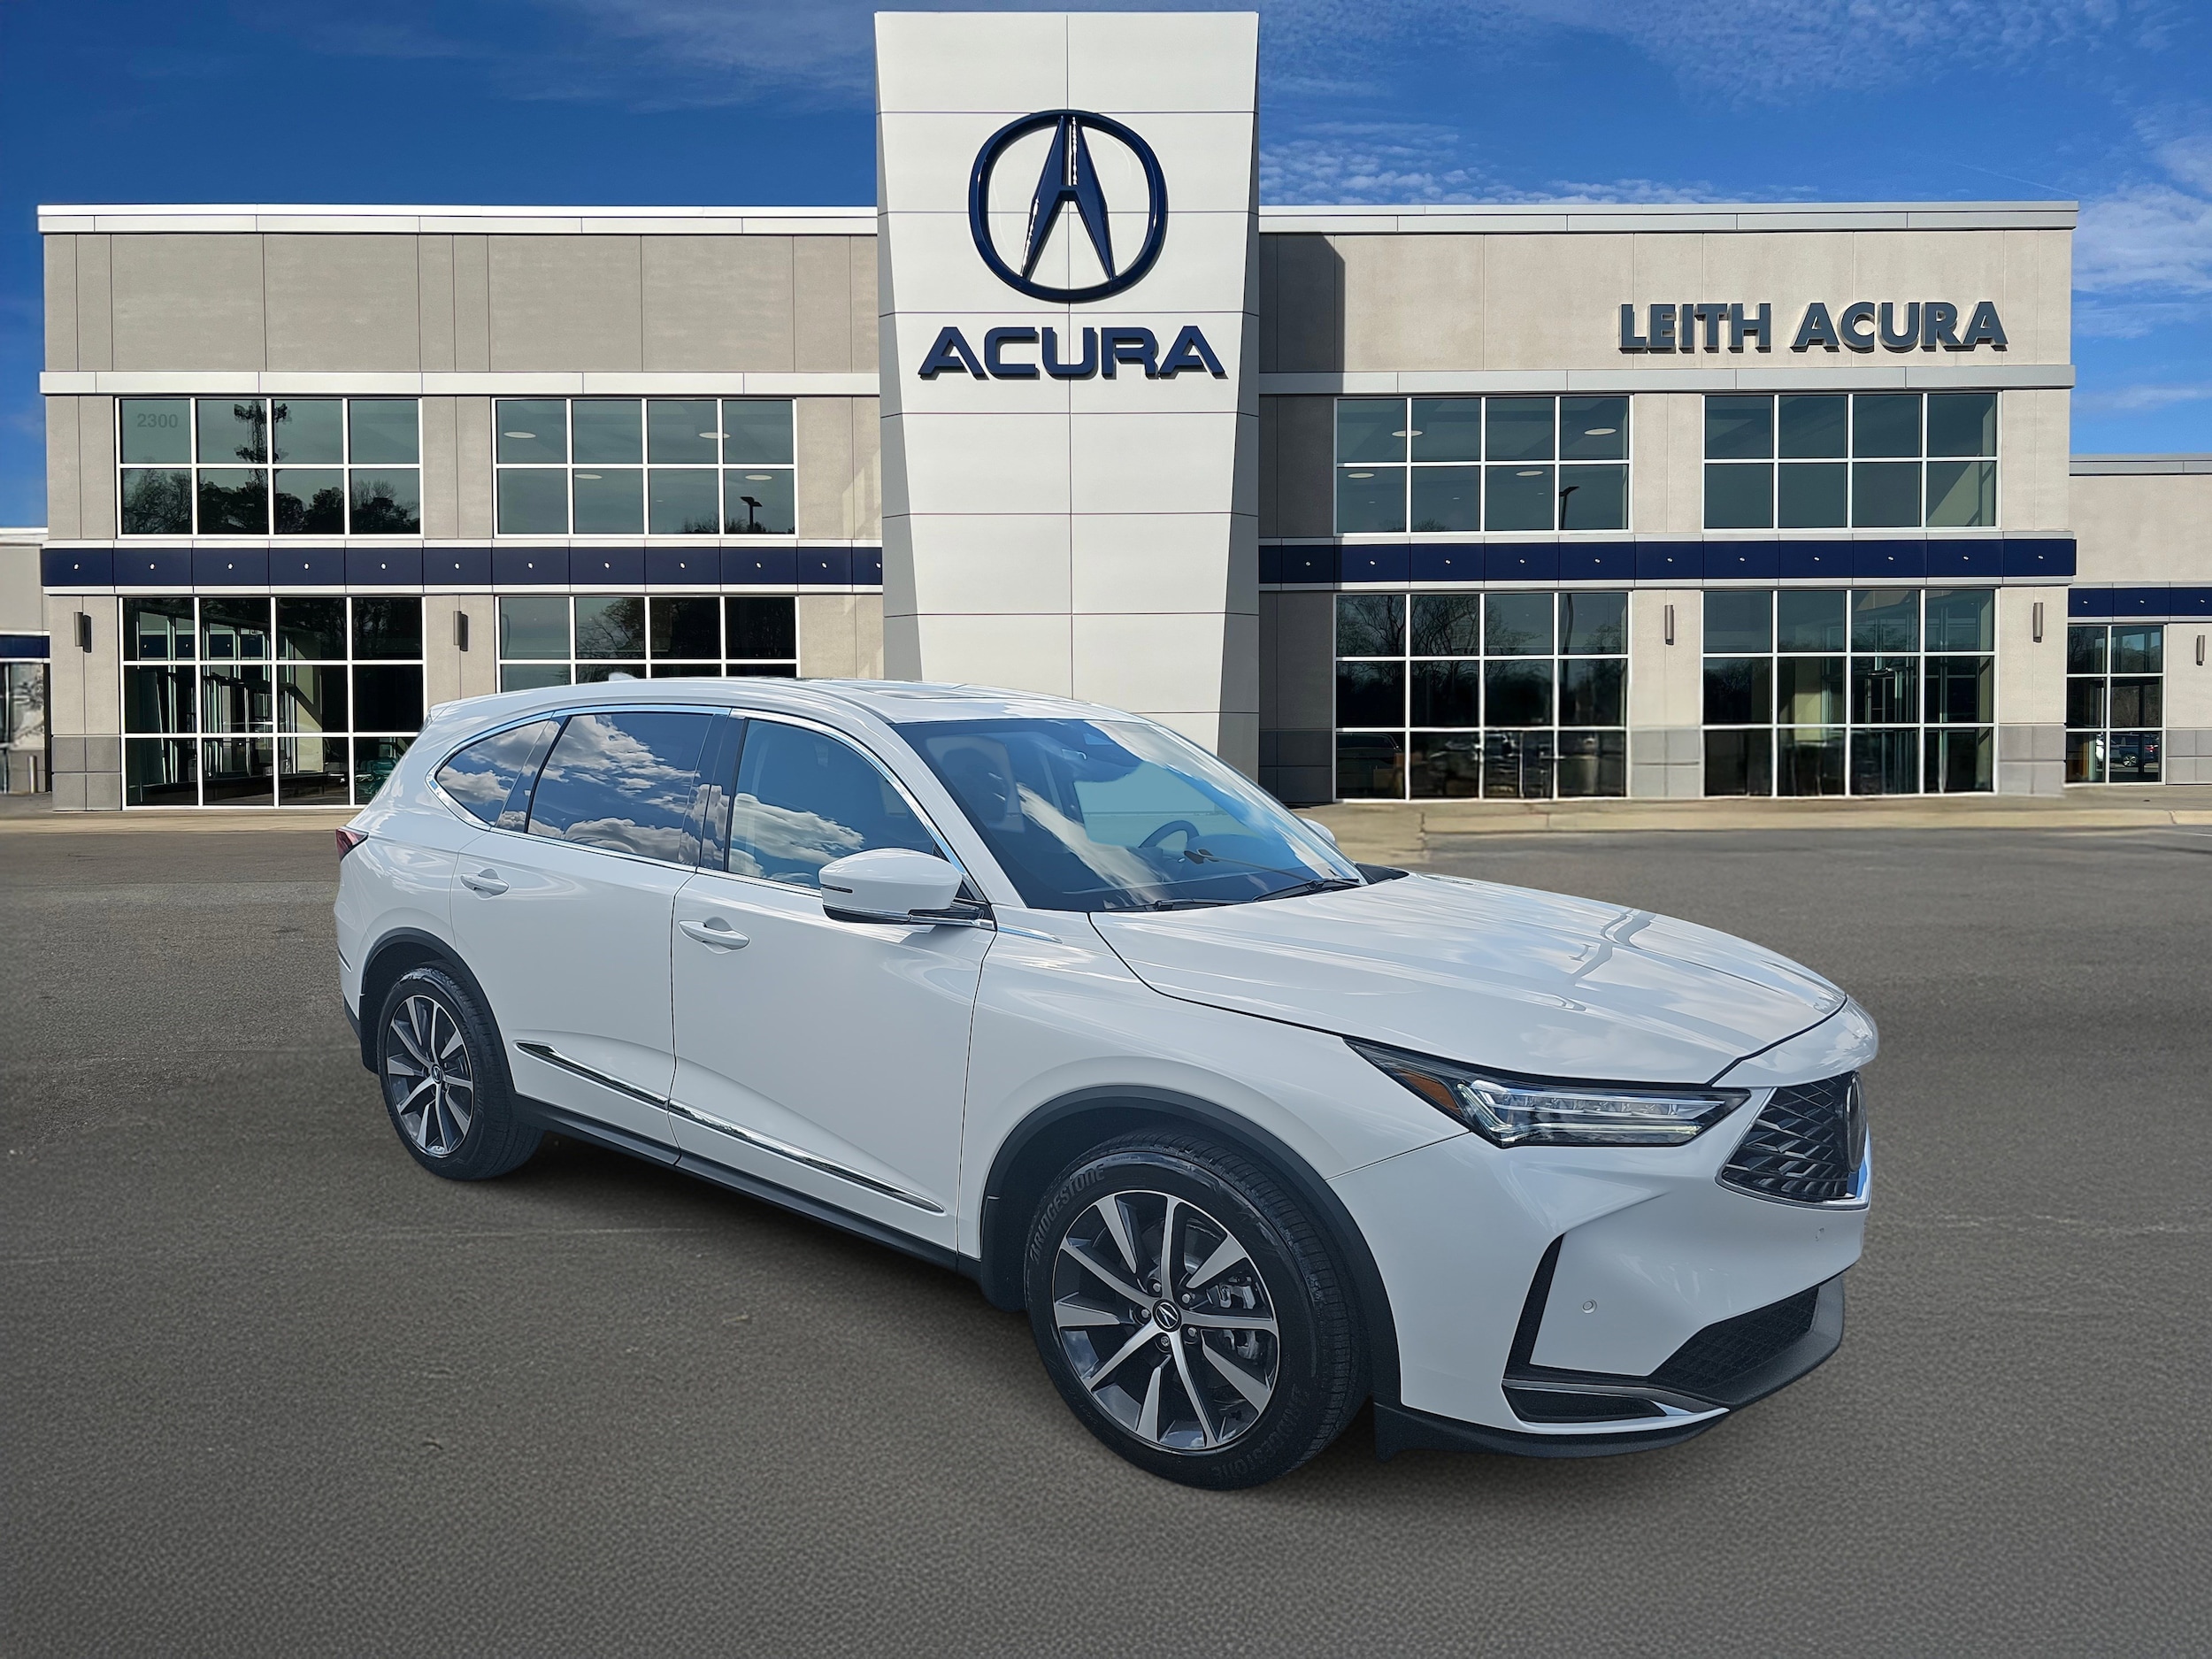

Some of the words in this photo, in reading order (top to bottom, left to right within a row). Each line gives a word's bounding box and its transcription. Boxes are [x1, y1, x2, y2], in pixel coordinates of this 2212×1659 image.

[918, 326, 1227, 379] ACURA
[1619, 303, 1771, 353] LEITH
[1790, 302, 2008, 353] ACURA
[137, 413, 178, 428] 2300
[1029, 1164, 1105, 1265] BRIDGESTONE
